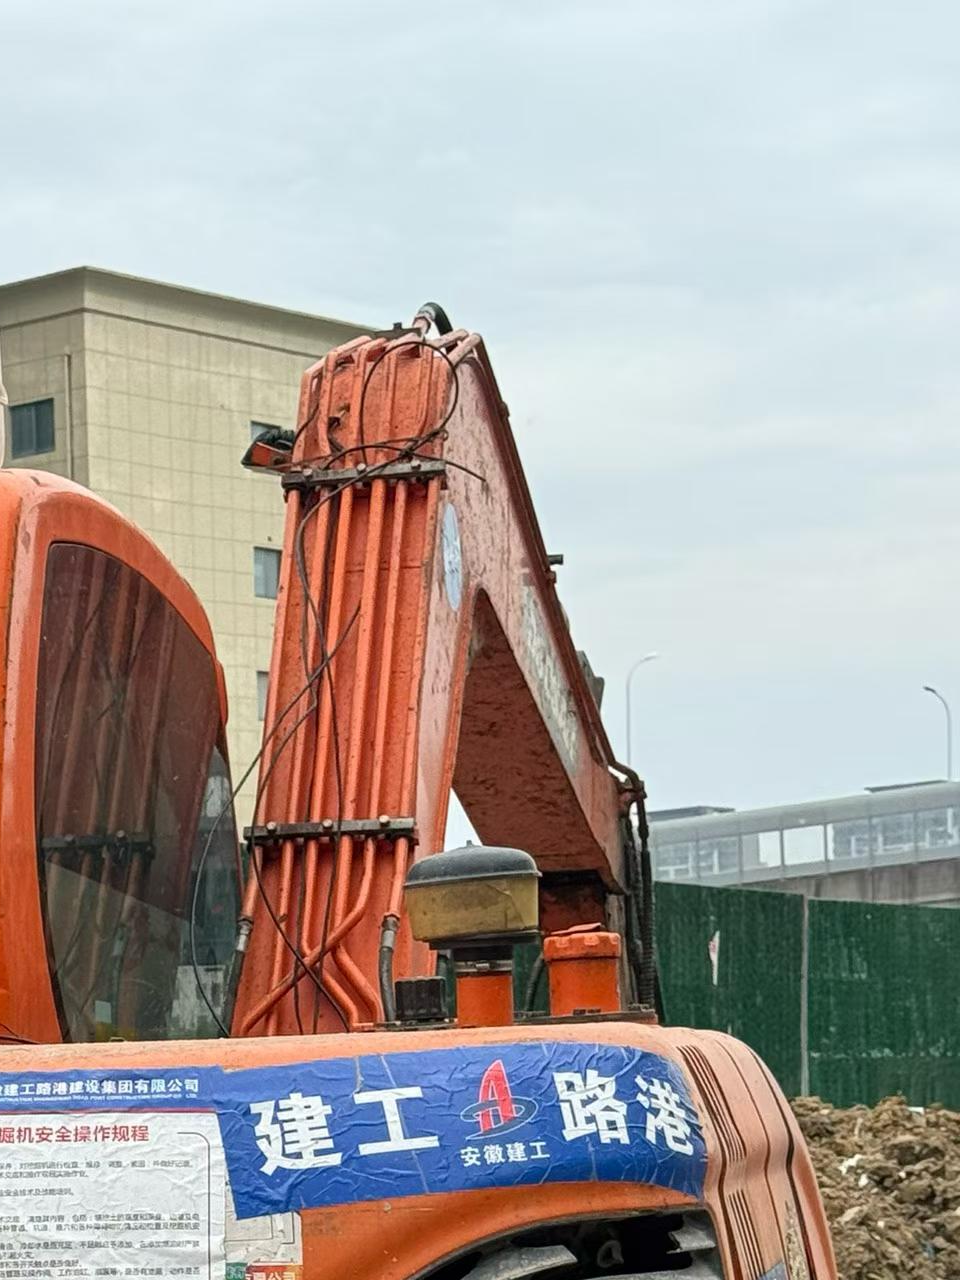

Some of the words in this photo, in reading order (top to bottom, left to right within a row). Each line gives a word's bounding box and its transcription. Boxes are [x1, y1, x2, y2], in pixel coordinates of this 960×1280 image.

[250, 1086, 440, 1176] 建工
[553, 1071, 695, 1158] 路港
[460, 1141, 551, 1168] 安徽建工
